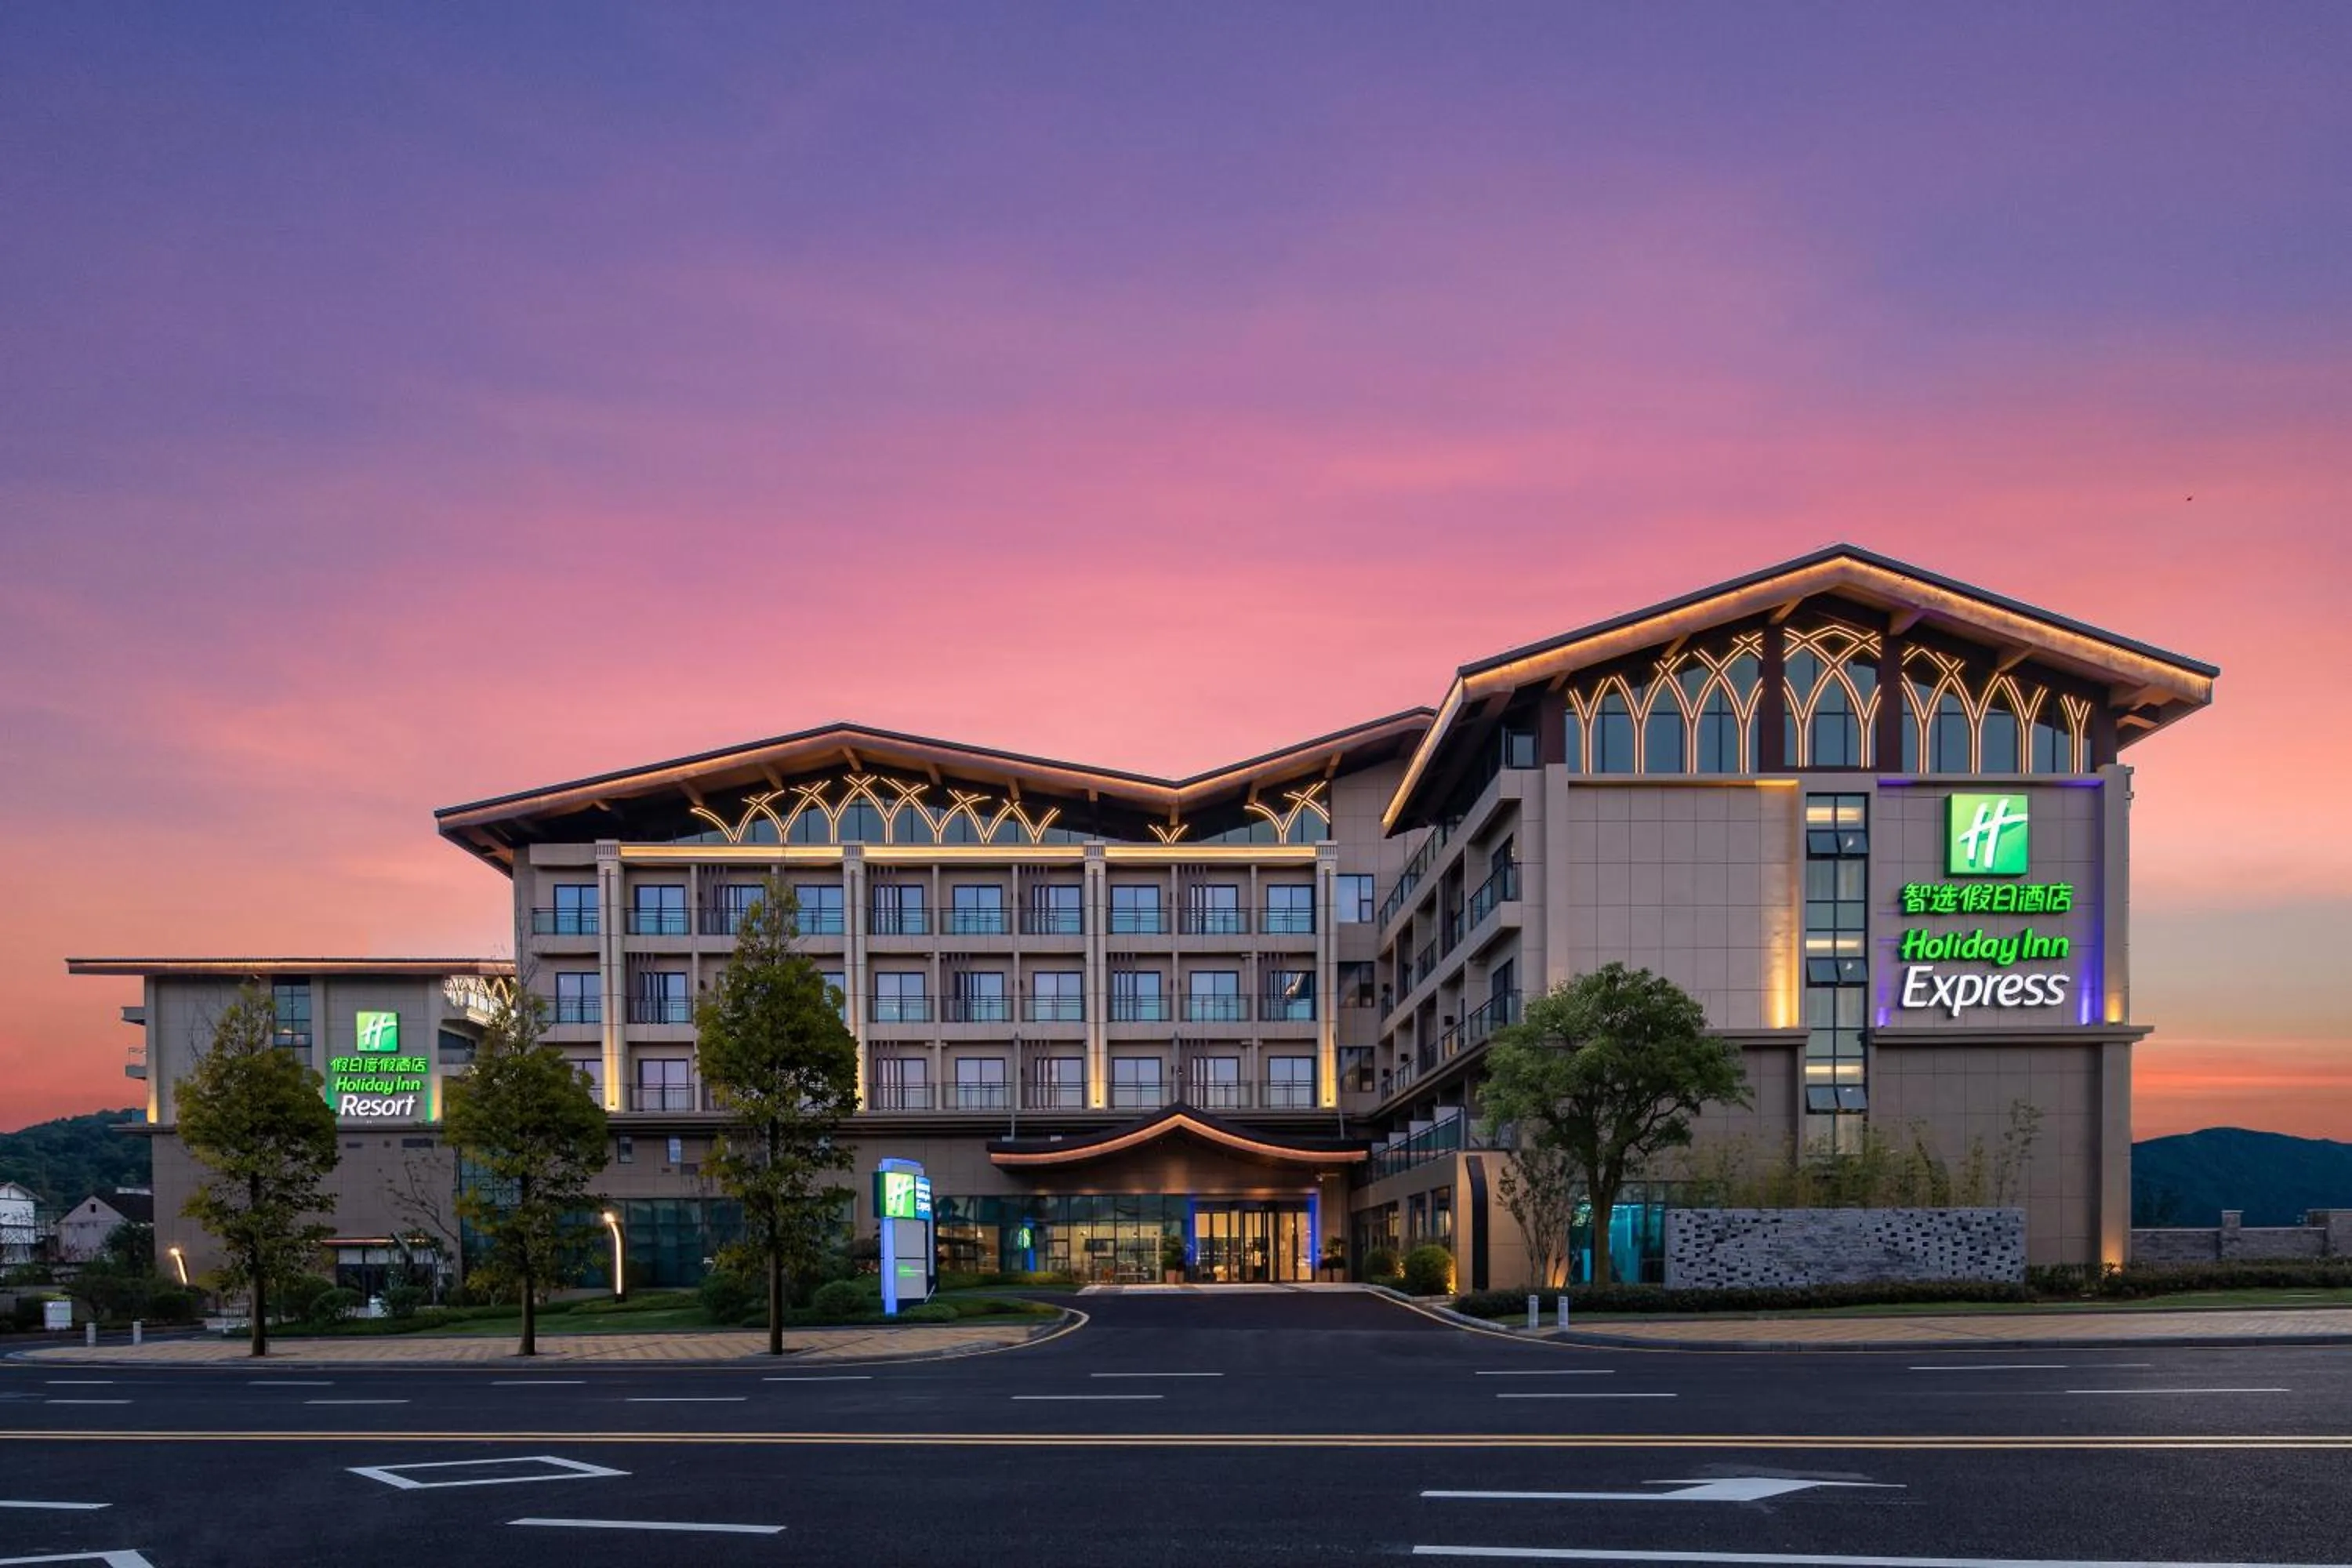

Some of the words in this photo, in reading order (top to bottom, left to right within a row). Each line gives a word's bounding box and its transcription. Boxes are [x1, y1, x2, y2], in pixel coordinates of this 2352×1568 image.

[1903, 882, 2074, 913] 智选假日酒店
[1900, 927, 2019, 966] Holiday
[2021, 927, 2070, 960] Inn
[1901, 965, 2071, 1018] Express
[335, 1076, 394, 1095] Holiday
[396, 1076, 421, 1091] Inn
[340, 1094, 416, 1116] Resort
